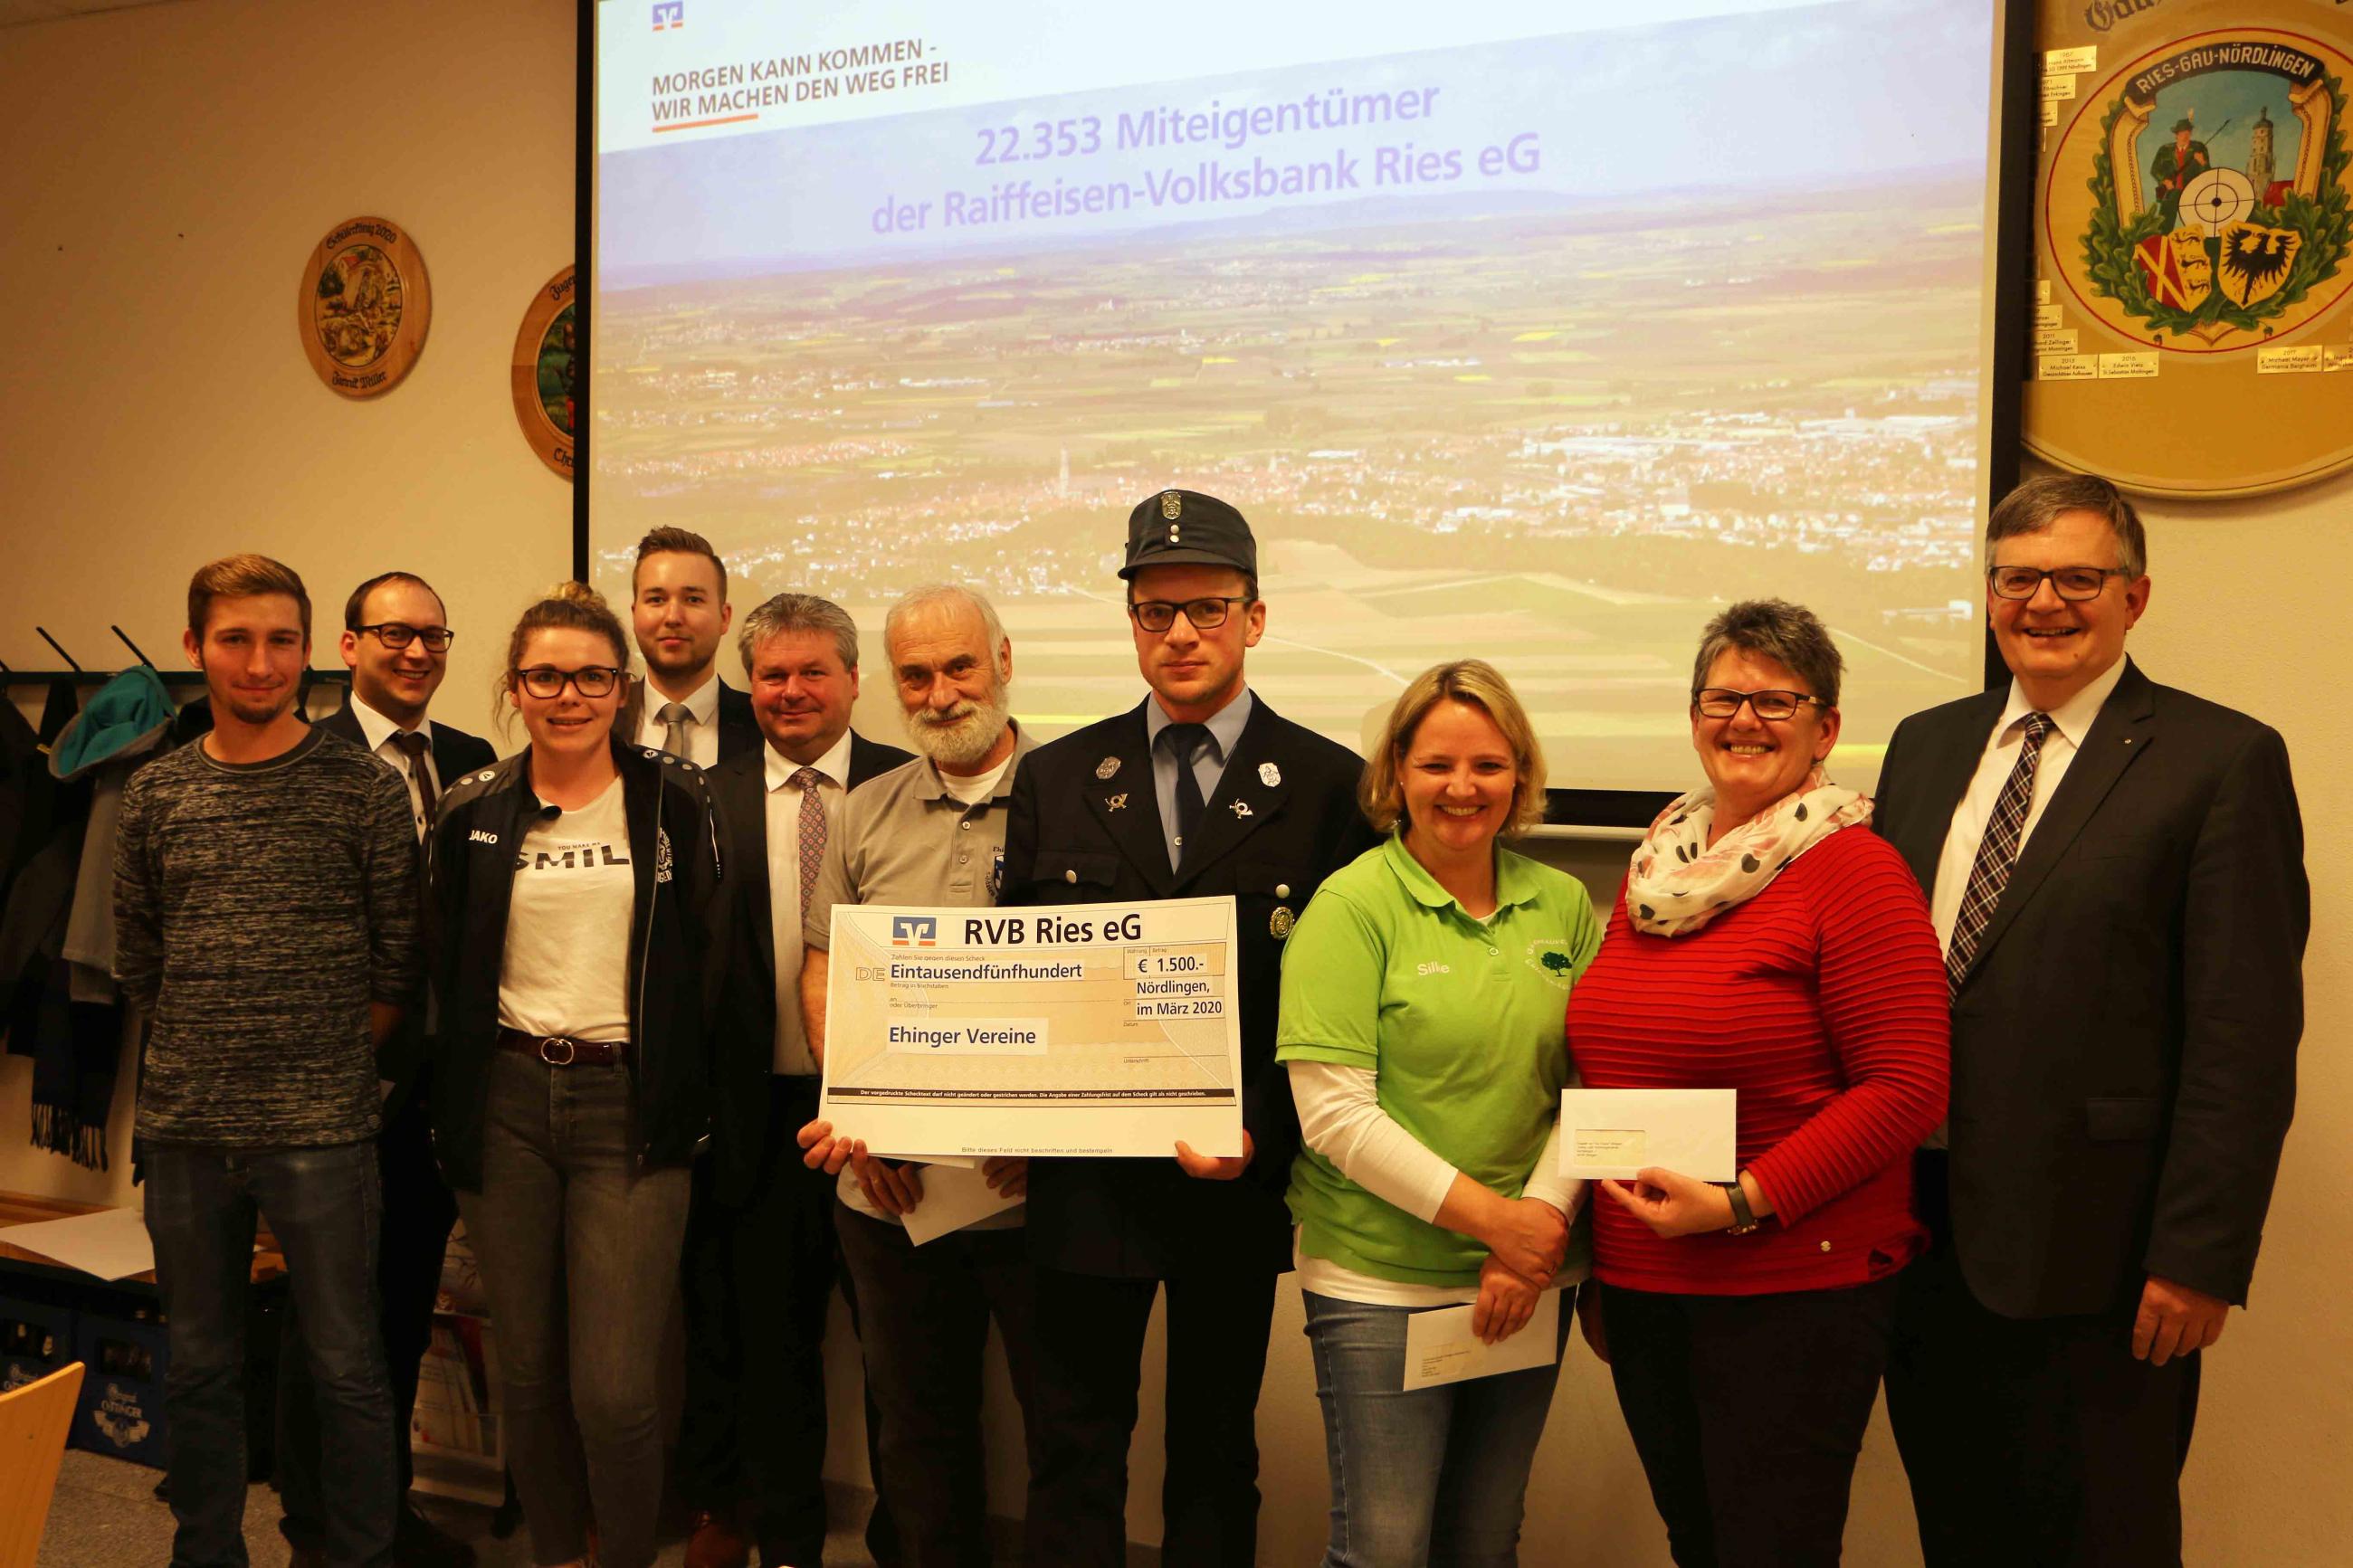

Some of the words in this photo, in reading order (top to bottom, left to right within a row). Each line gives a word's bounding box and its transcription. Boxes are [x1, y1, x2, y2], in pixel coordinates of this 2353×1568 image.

[653, 64, 744, 95] MORGEN
[750, 54, 812, 82] KANN
[818, 39, 923, 71] KOMMEN
[653, 90, 691, 121] WIR
[697, 81, 789, 116] MACHEN
[795, 71, 838, 101] DEN
[844, 68, 897, 95] WEG
[902, 62, 949, 88] FREI
[975, 114, 1101, 166] 22.353
[1117, 86, 1441, 151] Miteigentümer
[872, 194, 932, 235] der
[944, 148, 1359, 228] Raiffeisen-Volksbank
[1374, 142, 1463, 186] Ries
[1477, 131, 1540, 177] eG
[469, 830, 498, 844] JAKO
[515, 844, 630, 870] SMIL
[965, 918, 1024, 946] RVB
[1036, 916, 1093, 944] Ries
[1103, 914, 1141, 942] eG
[855, 966, 885, 982] DE
[891, 963, 1082, 981] Eintausendfünfhundert
[1138, 959, 1148, 973] €
[1157, 956, 1204, 972] 1.500.-
[1417, 961, 1450, 976] Sille
[1137, 980, 1210, 996] Nördlingen,
[1137, 1003, 1153, 1016] im
[1157, 1003, 1189, 1015] März
[1192, 1001, 1223, 1013] 2020
[890, 1026, 961, 1049] Ehinger
[966, 1027, 1036, 1044] Vereine
